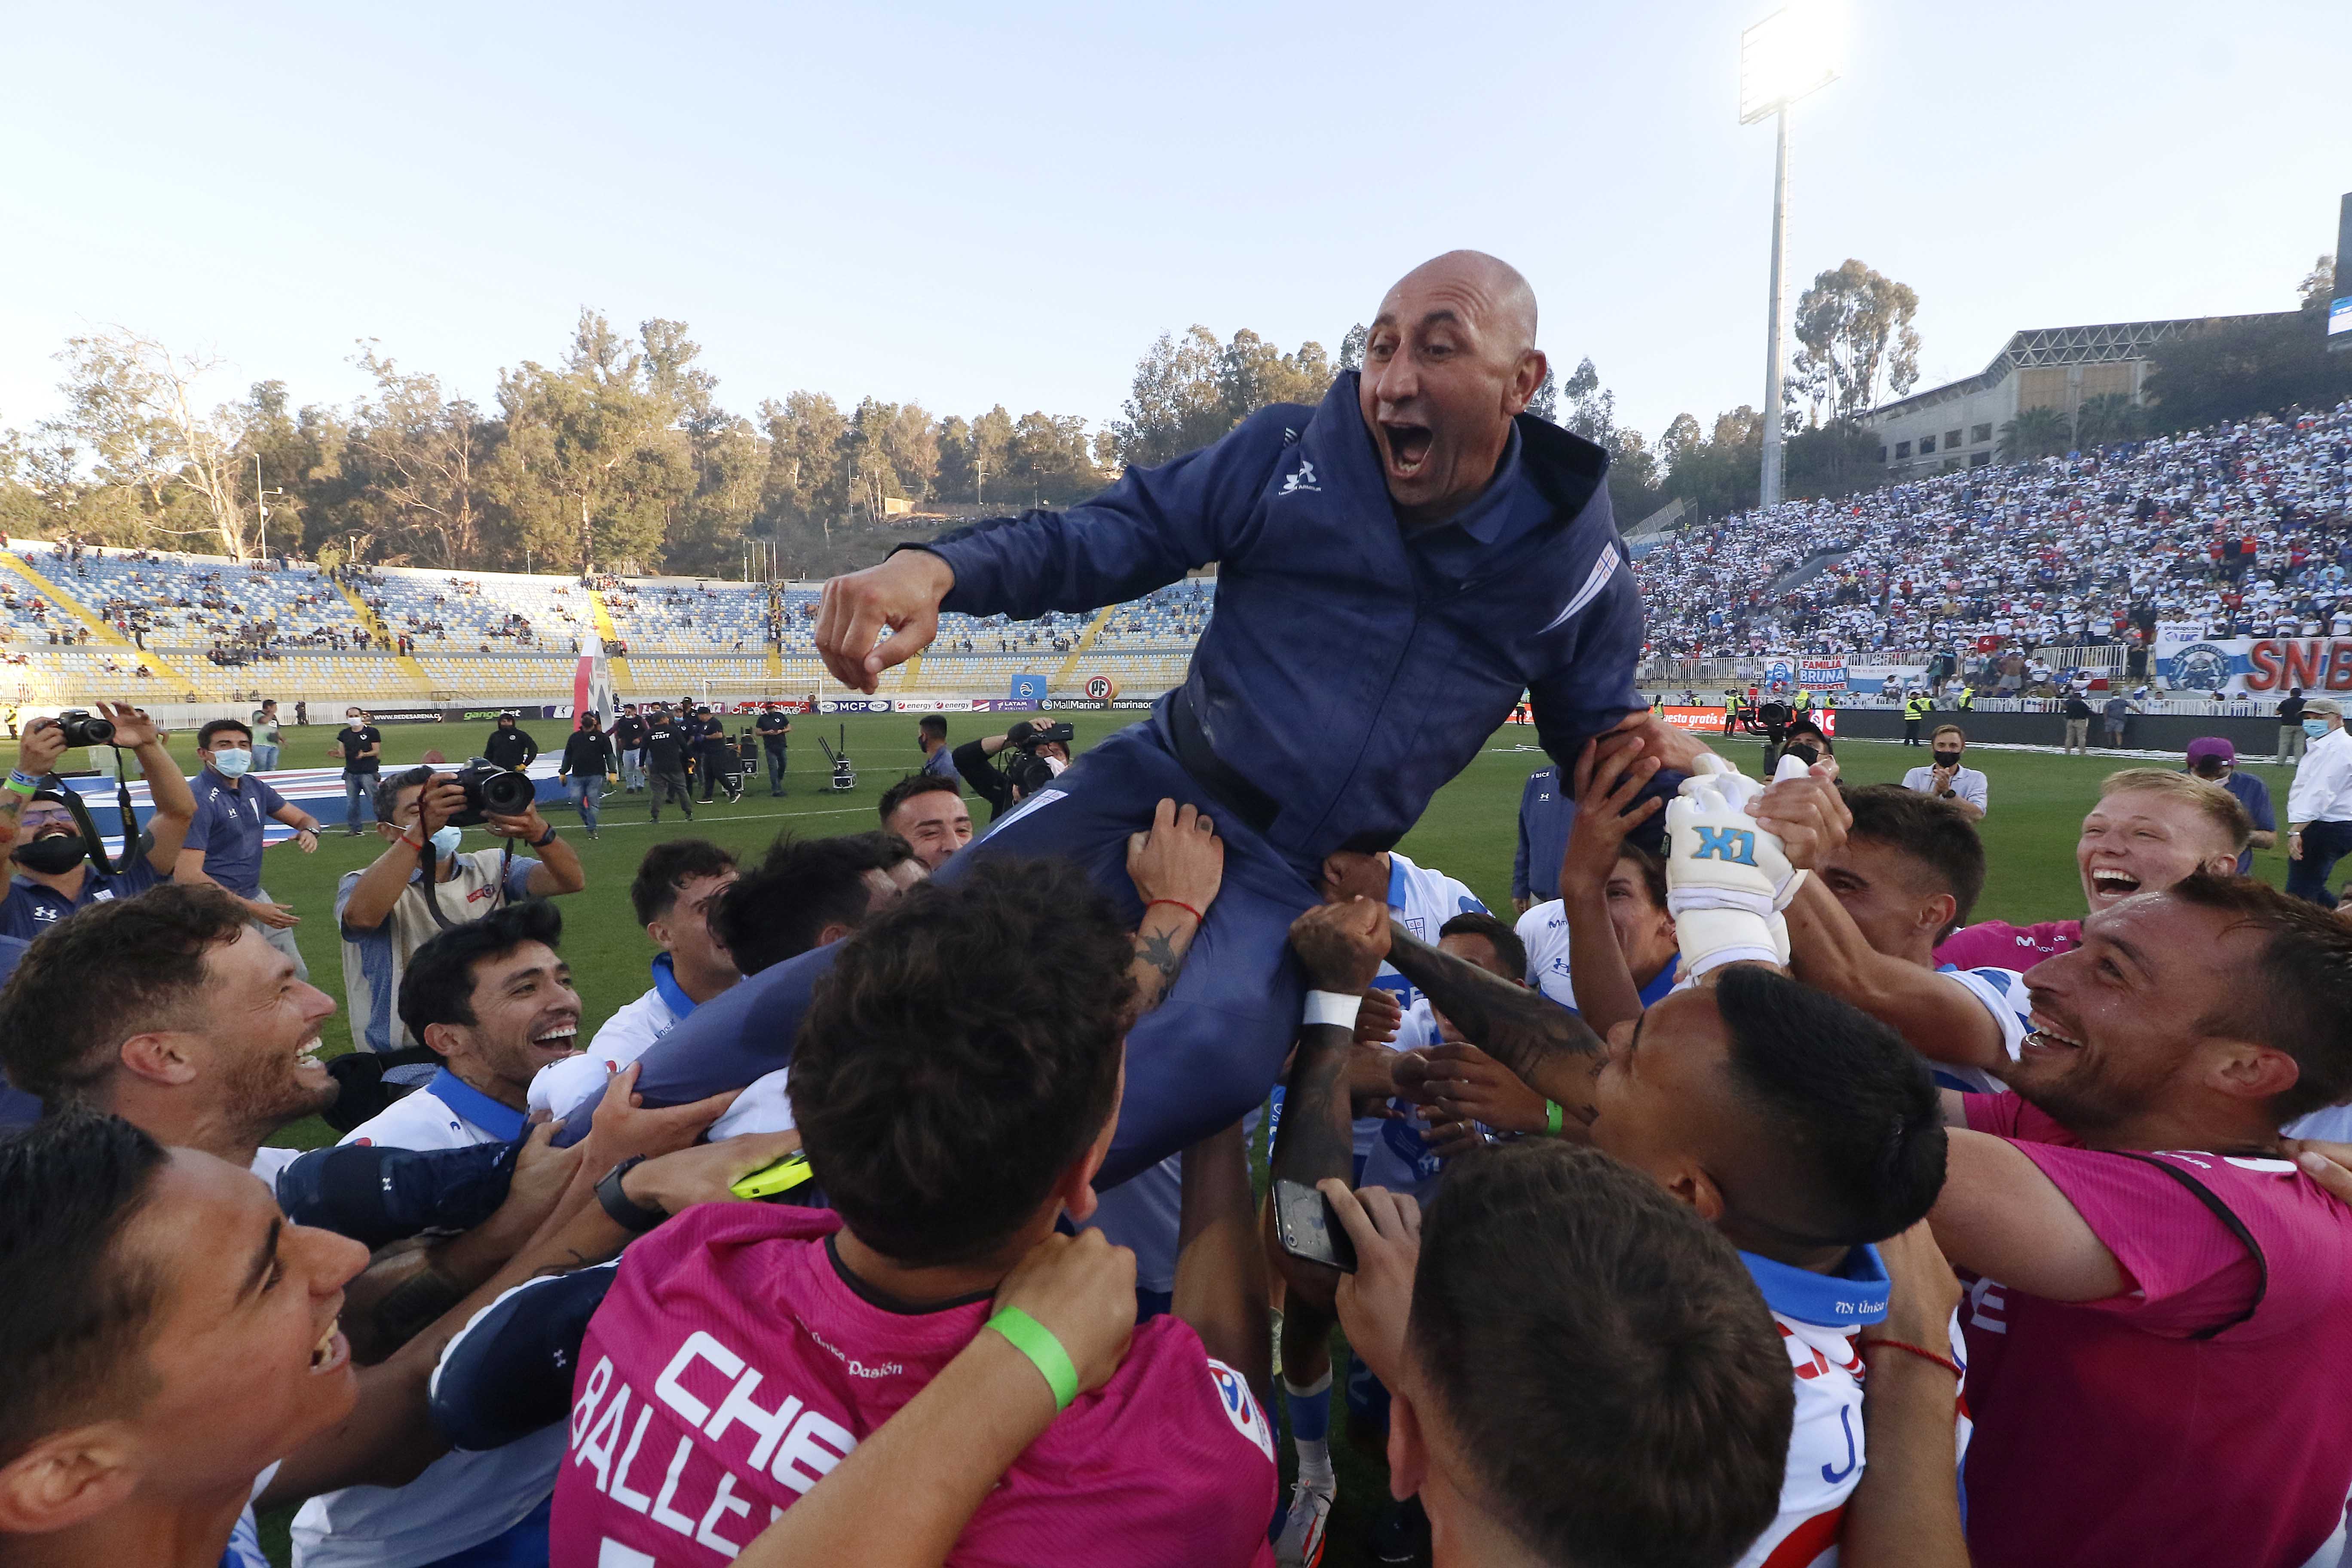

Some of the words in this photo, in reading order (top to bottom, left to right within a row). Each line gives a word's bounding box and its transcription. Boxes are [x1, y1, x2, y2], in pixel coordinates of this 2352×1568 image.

[1803, 660, 1842, 669] FAMILIA
[1800, 669, 1845, 683] BRUNA
[1091, 680, 1106, 696] PF
[839, 702, 867, 710] MCP
[463, 709, 521, 720] gangabet
[1688, 713, 1717, 726] gratis
[572, 1355, 783, 1560] BALLE
